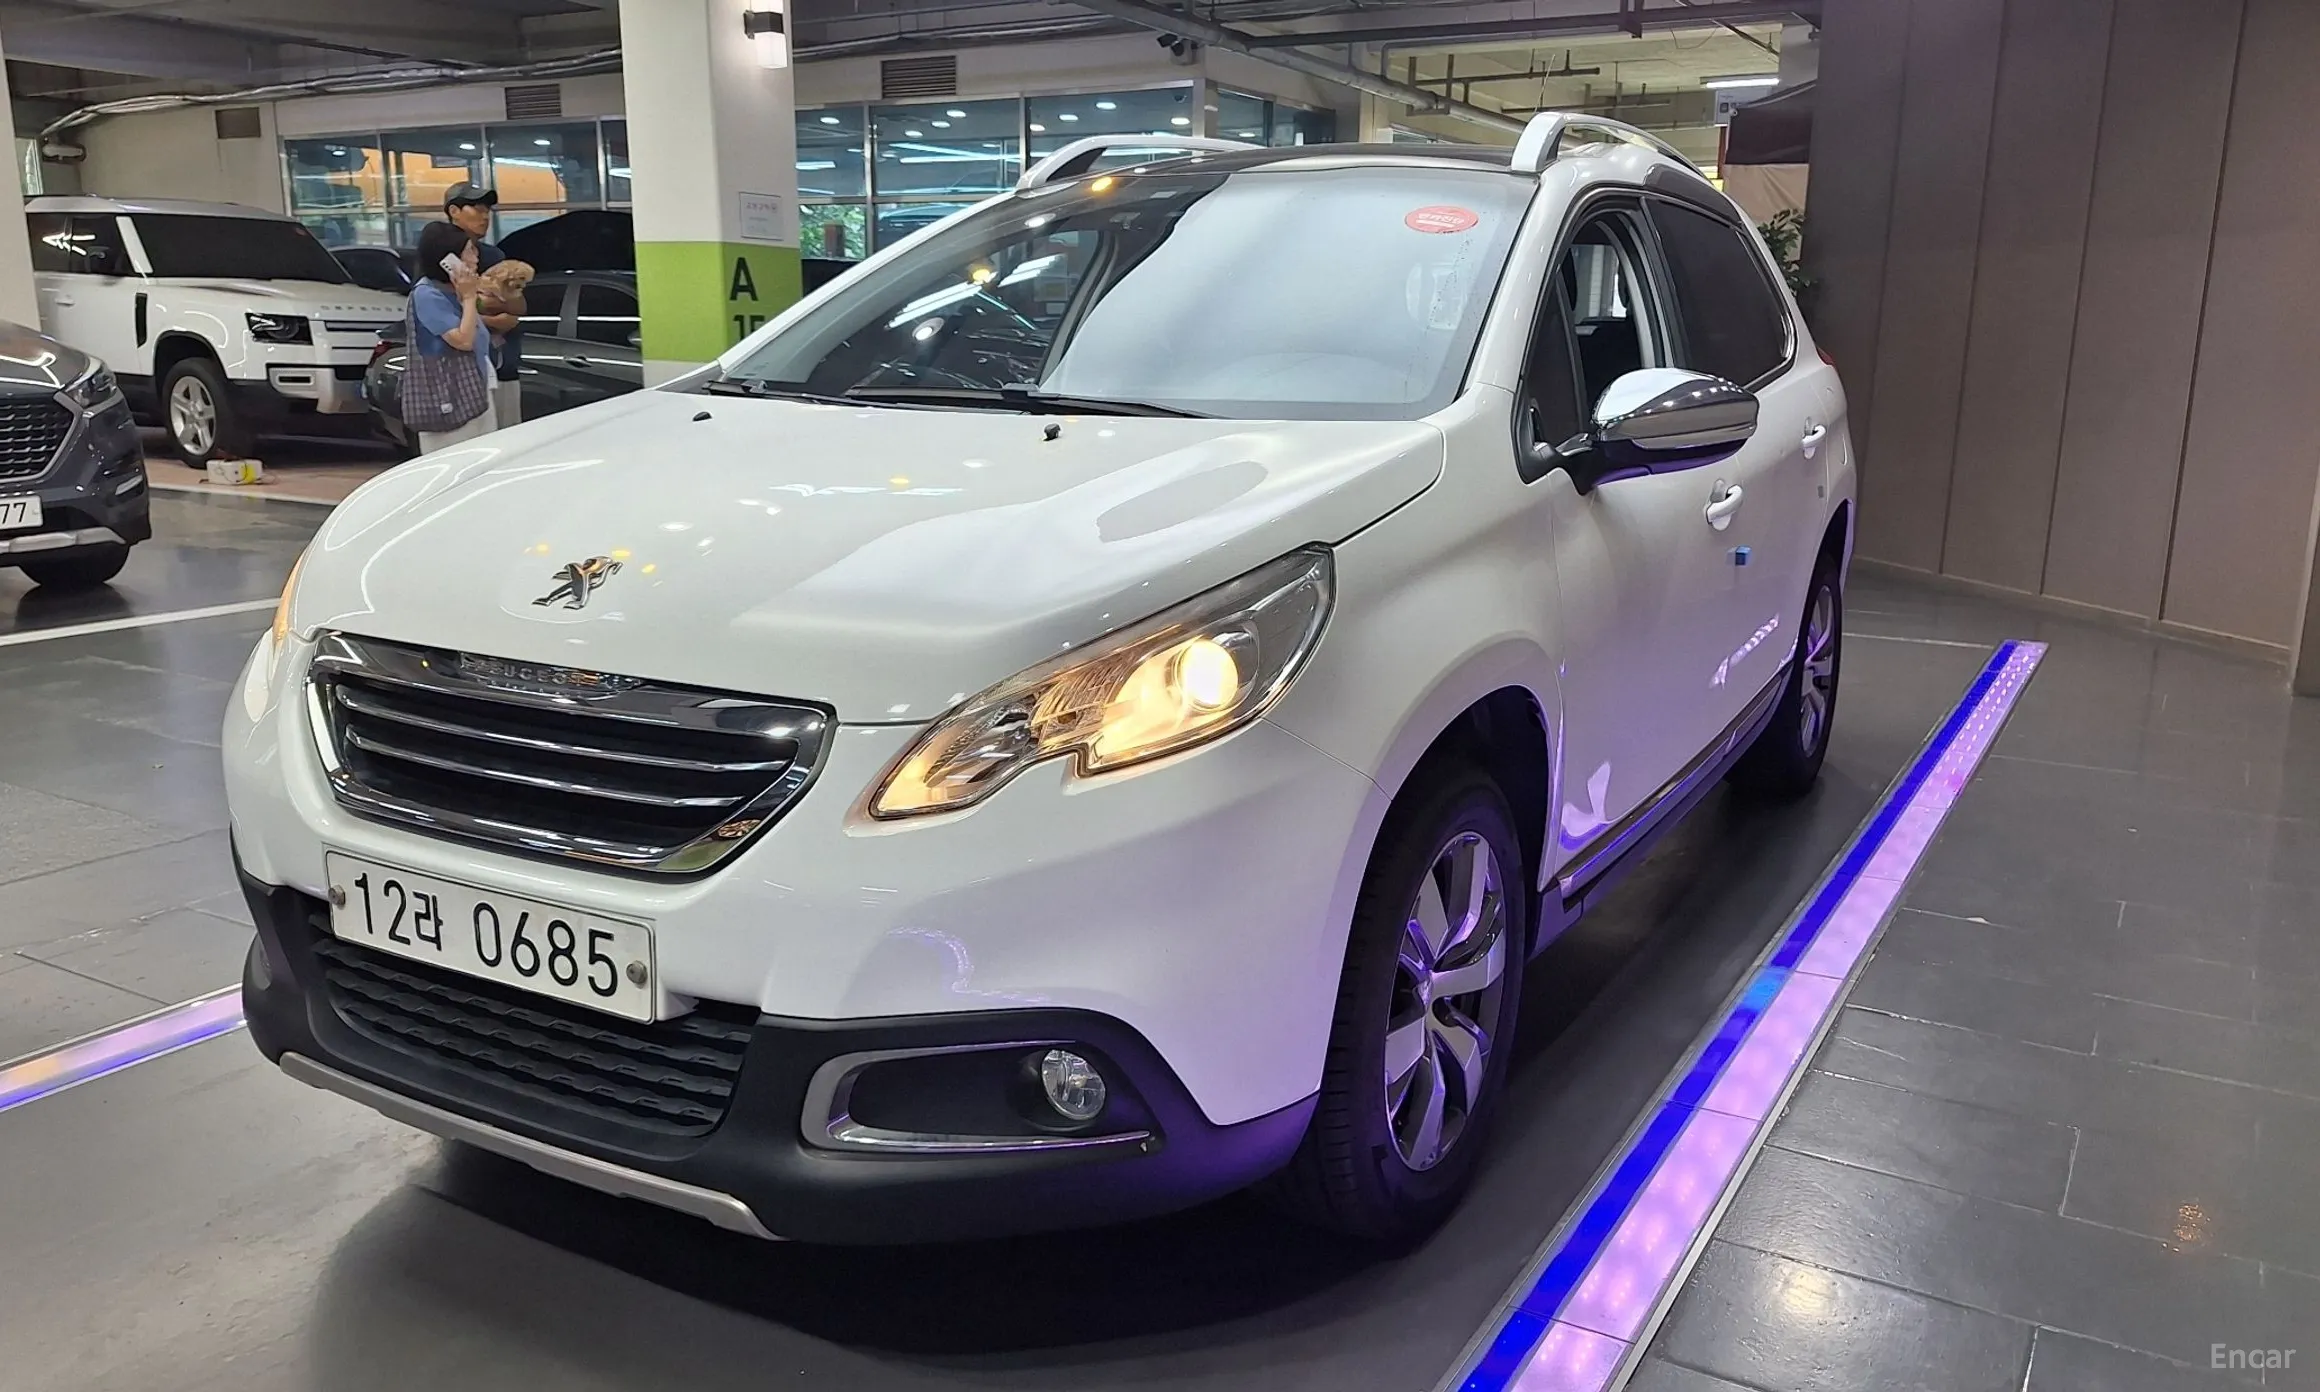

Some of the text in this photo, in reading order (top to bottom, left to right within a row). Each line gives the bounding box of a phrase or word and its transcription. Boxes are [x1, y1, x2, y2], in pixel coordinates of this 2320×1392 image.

[729, 257, 759, 301] A
[355, 872, 618, 997] 12라 0685
